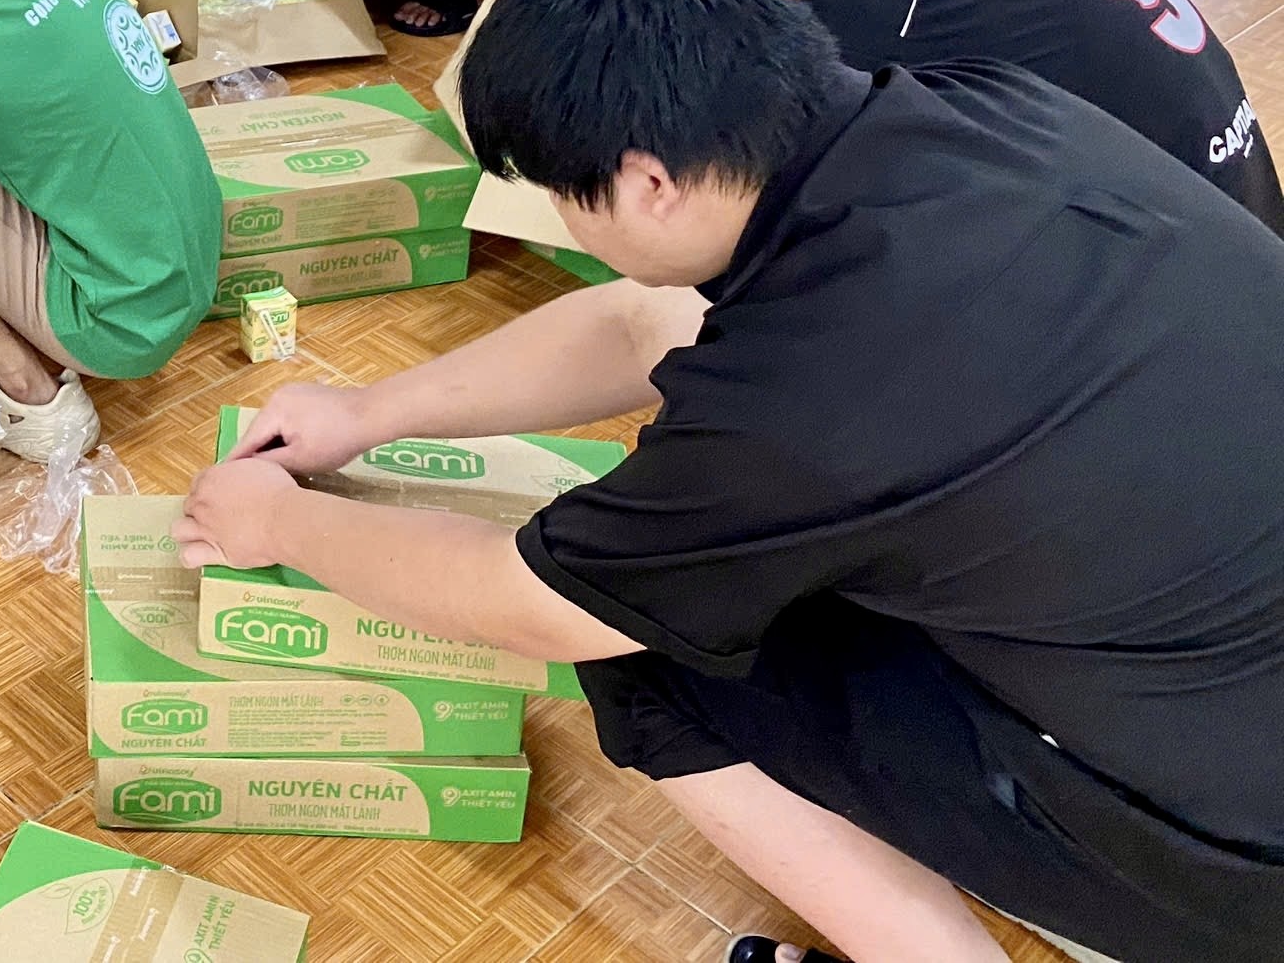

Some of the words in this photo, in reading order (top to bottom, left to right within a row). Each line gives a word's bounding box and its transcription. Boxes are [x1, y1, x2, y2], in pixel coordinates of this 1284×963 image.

[229, 210, 282, 231] Fami
[299, 255, 359, 275] NGUYÊN
[362, 249, 399, 267] CHẤT
[369, 448, 478, 474] Fami
[220, 611, 321, 650] Fami
[413, 648, 439, 665] NGON
[442, 650, 465, 667] MÁT
[126, 704, 204, 726] Fami
[119, 787, 216, 813] Fami
[248, 779, 341, 798] NGUYÊN
[349, 779, 408, 802] CHẤT
[298, 804, 328, 818] NGON
[330, 803, 351, 819] MÁT
